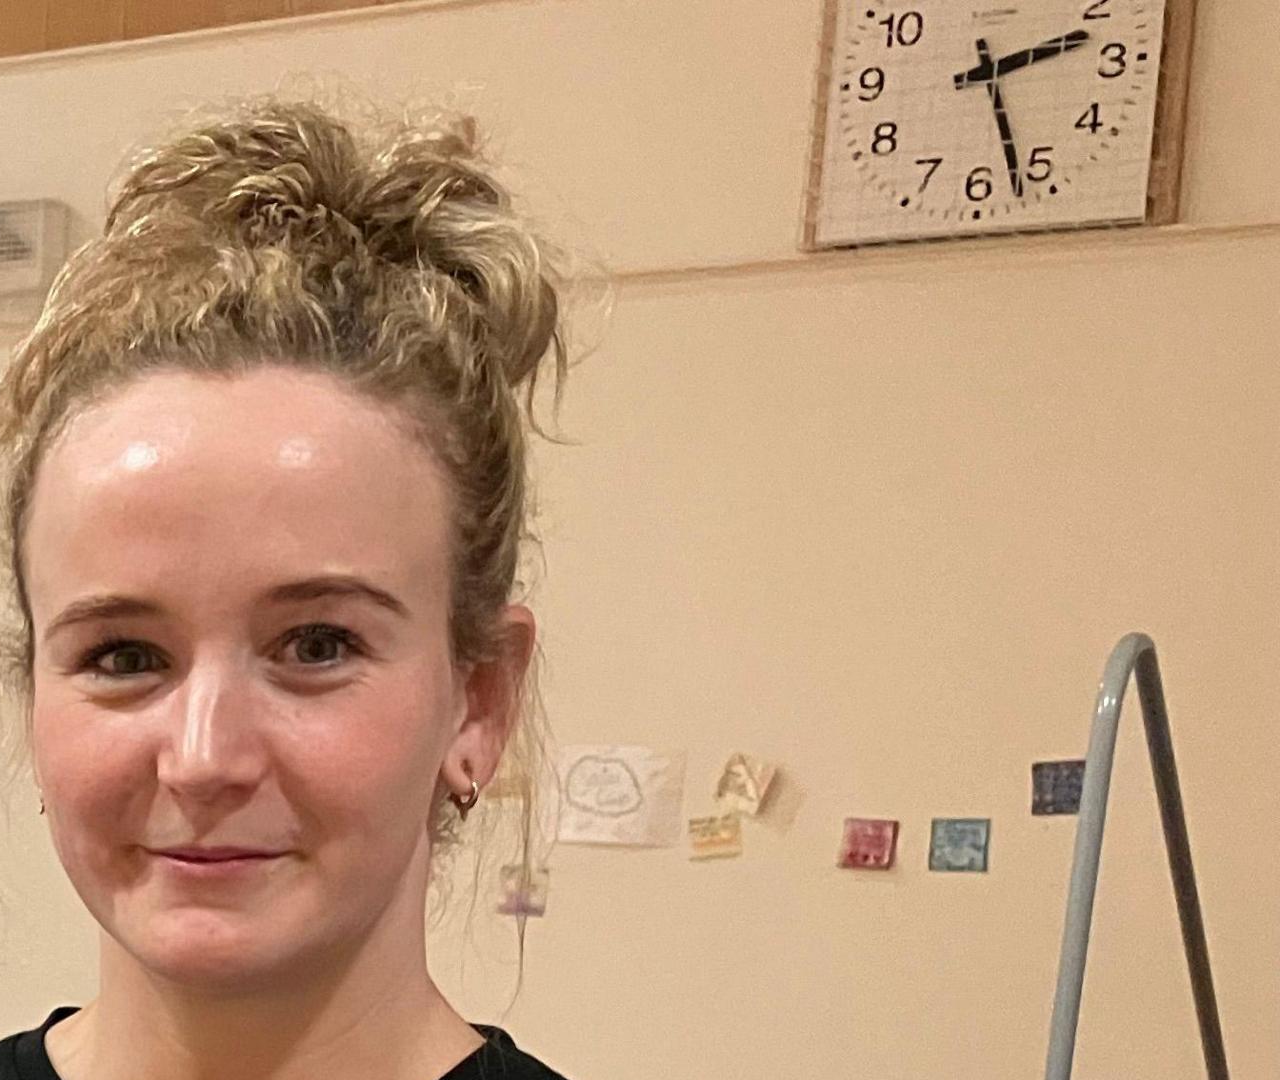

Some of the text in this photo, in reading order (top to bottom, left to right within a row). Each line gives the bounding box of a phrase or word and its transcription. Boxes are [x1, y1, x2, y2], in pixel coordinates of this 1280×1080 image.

[878, 11, 924, 49] 10
[1097, 42, 1127, 79] 3
[858, 66, 885, 102] 9
[1074, 102, 1104, 135] 4
[870, 121, 898, 156] 8
[915, 157, 944, 194] 7
[1025, 146, 1054, 182] 5
[965, 166, 993, 202] 6
